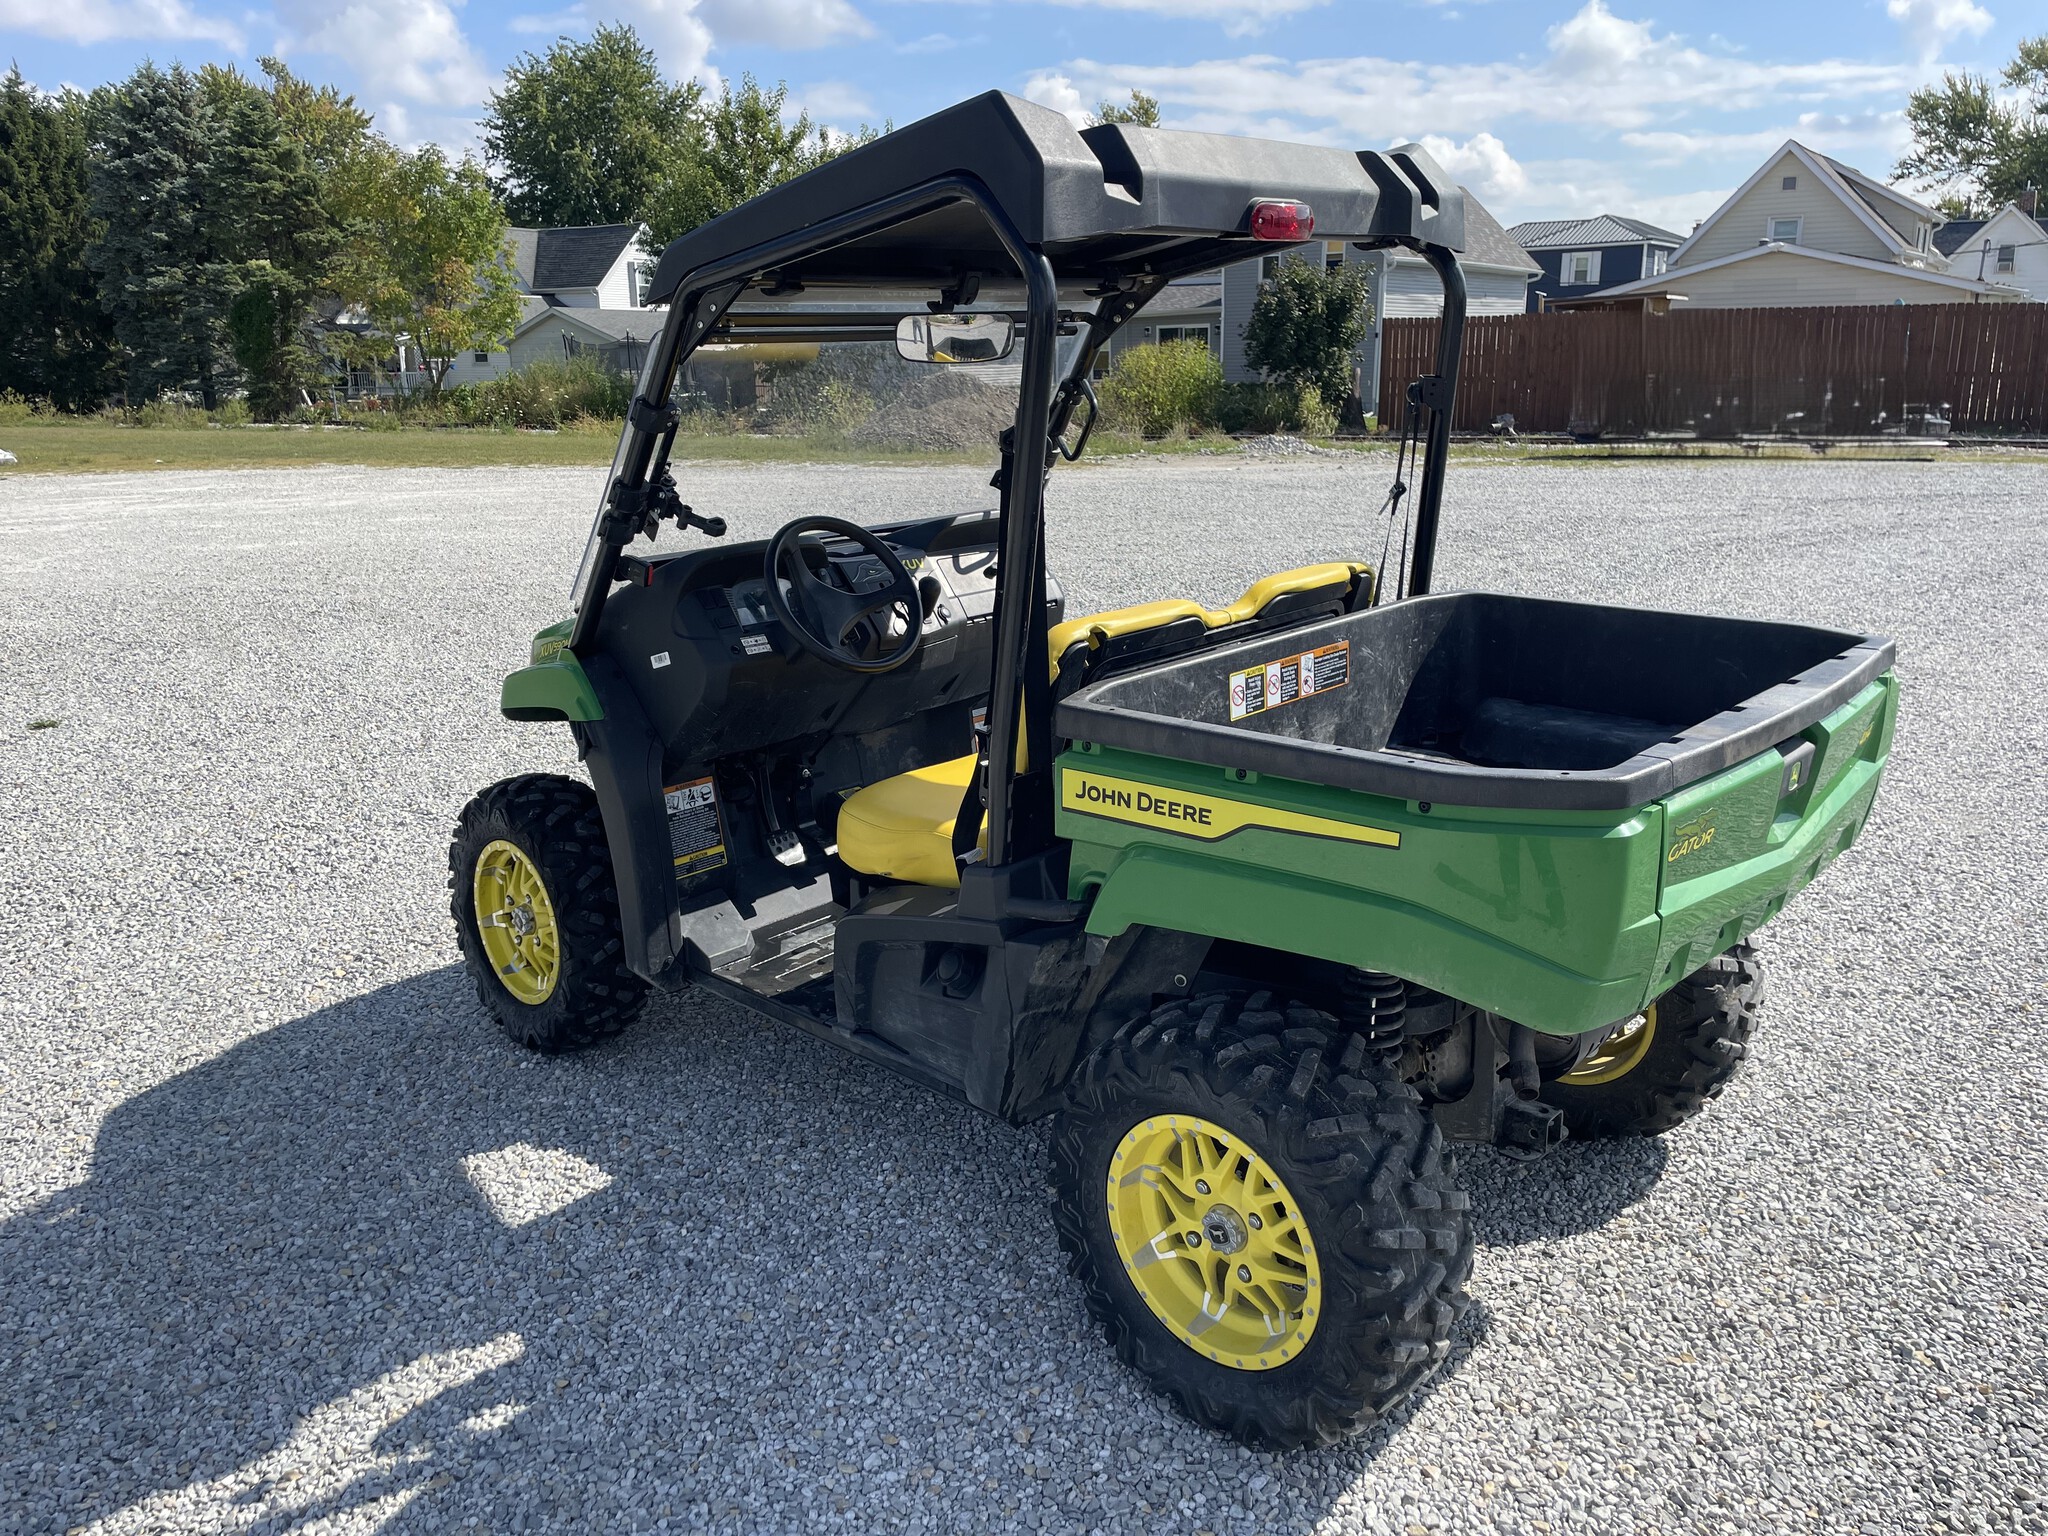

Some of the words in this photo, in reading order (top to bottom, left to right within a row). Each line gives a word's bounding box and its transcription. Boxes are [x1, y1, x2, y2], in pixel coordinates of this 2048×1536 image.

[902, 557, 924, 569] XUV
[1075, 780, 1132, 809] JOHN
[1137, 791, 1212, 826] DEERE
